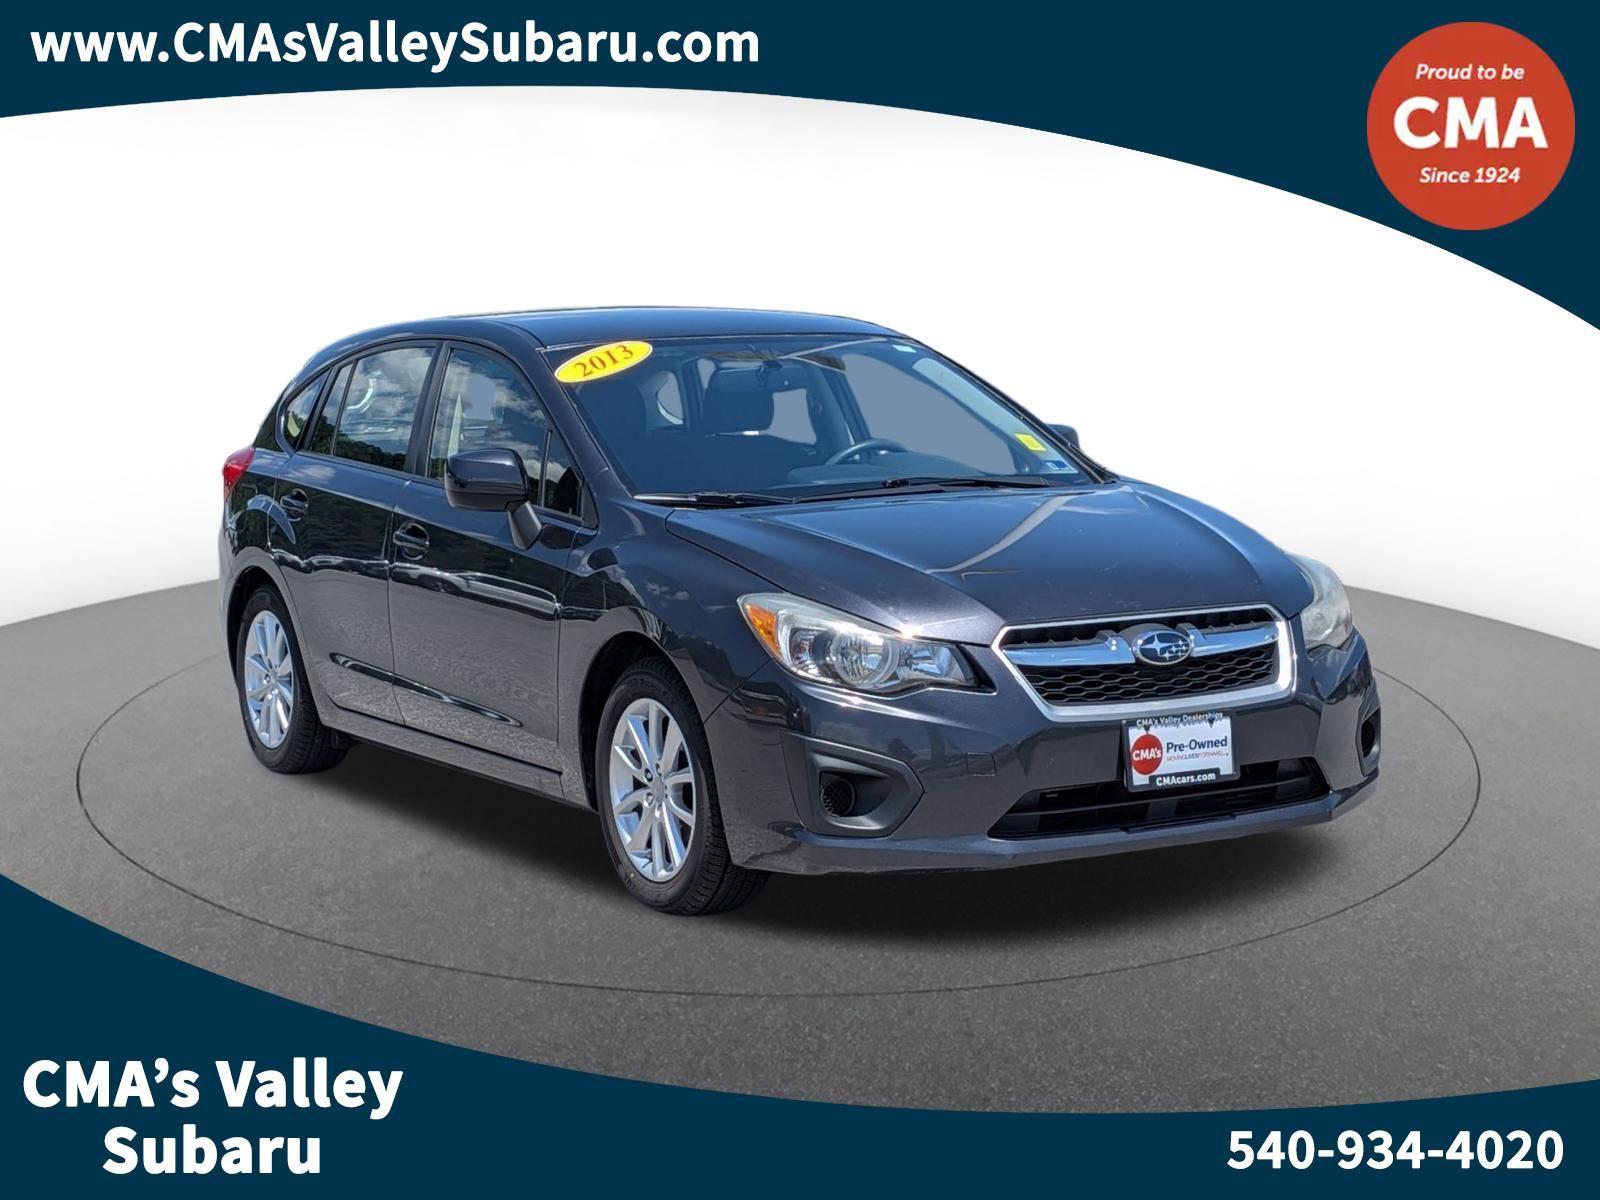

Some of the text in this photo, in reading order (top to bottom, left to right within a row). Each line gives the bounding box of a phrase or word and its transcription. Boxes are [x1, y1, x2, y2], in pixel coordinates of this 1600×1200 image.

[574, 345, 634, 377] 2013
[1166, 736, 1228, 753] Pre-Owned
[1132, 748, 1162, 762] CMA's
[1156, 773, 1216, 787] CMAcars.com
